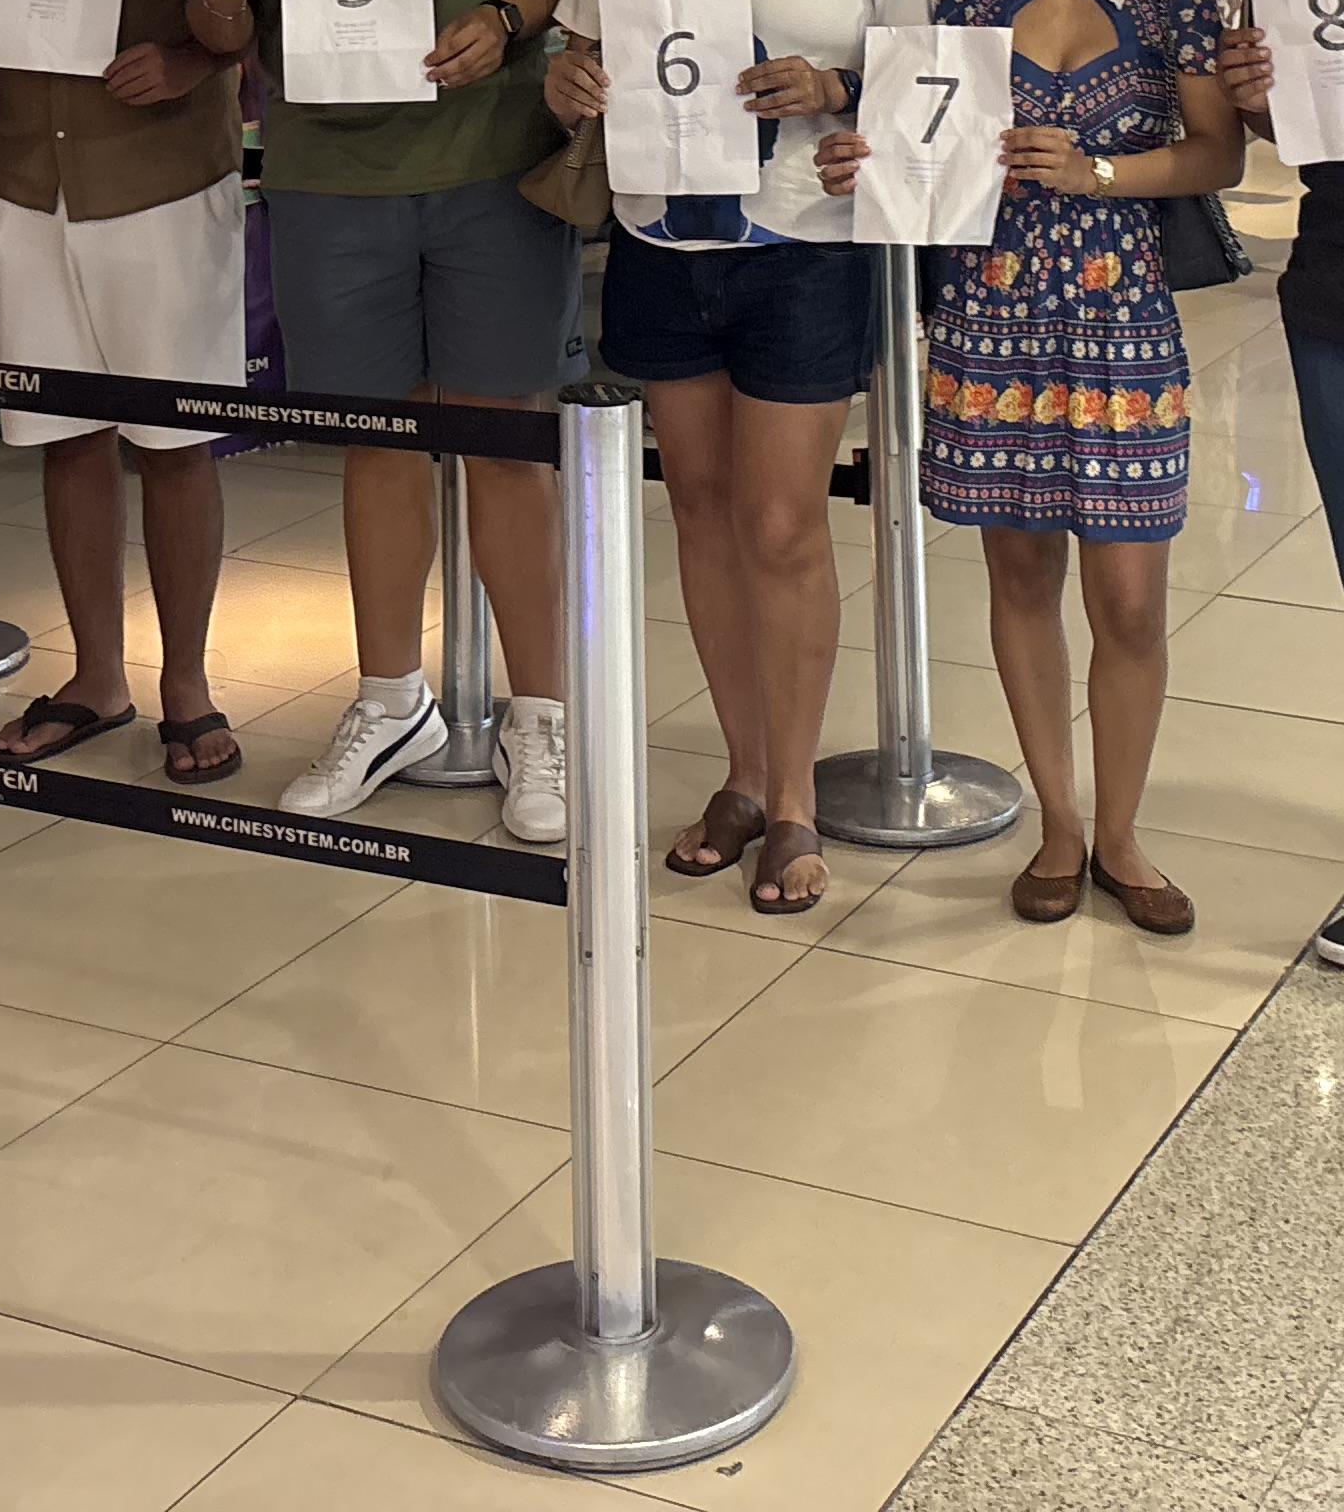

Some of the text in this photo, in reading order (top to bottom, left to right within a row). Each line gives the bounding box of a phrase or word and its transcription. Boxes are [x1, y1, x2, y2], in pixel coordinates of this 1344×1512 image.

[657, 32, 700, 96] 6
[916, 77, 959, 143] 7
[176, 397, 419, 435] WWW.CINESYSTEM.COM.BR
[171, 807, 411, 863] WWW.CINESYSTEM.COM.BR
